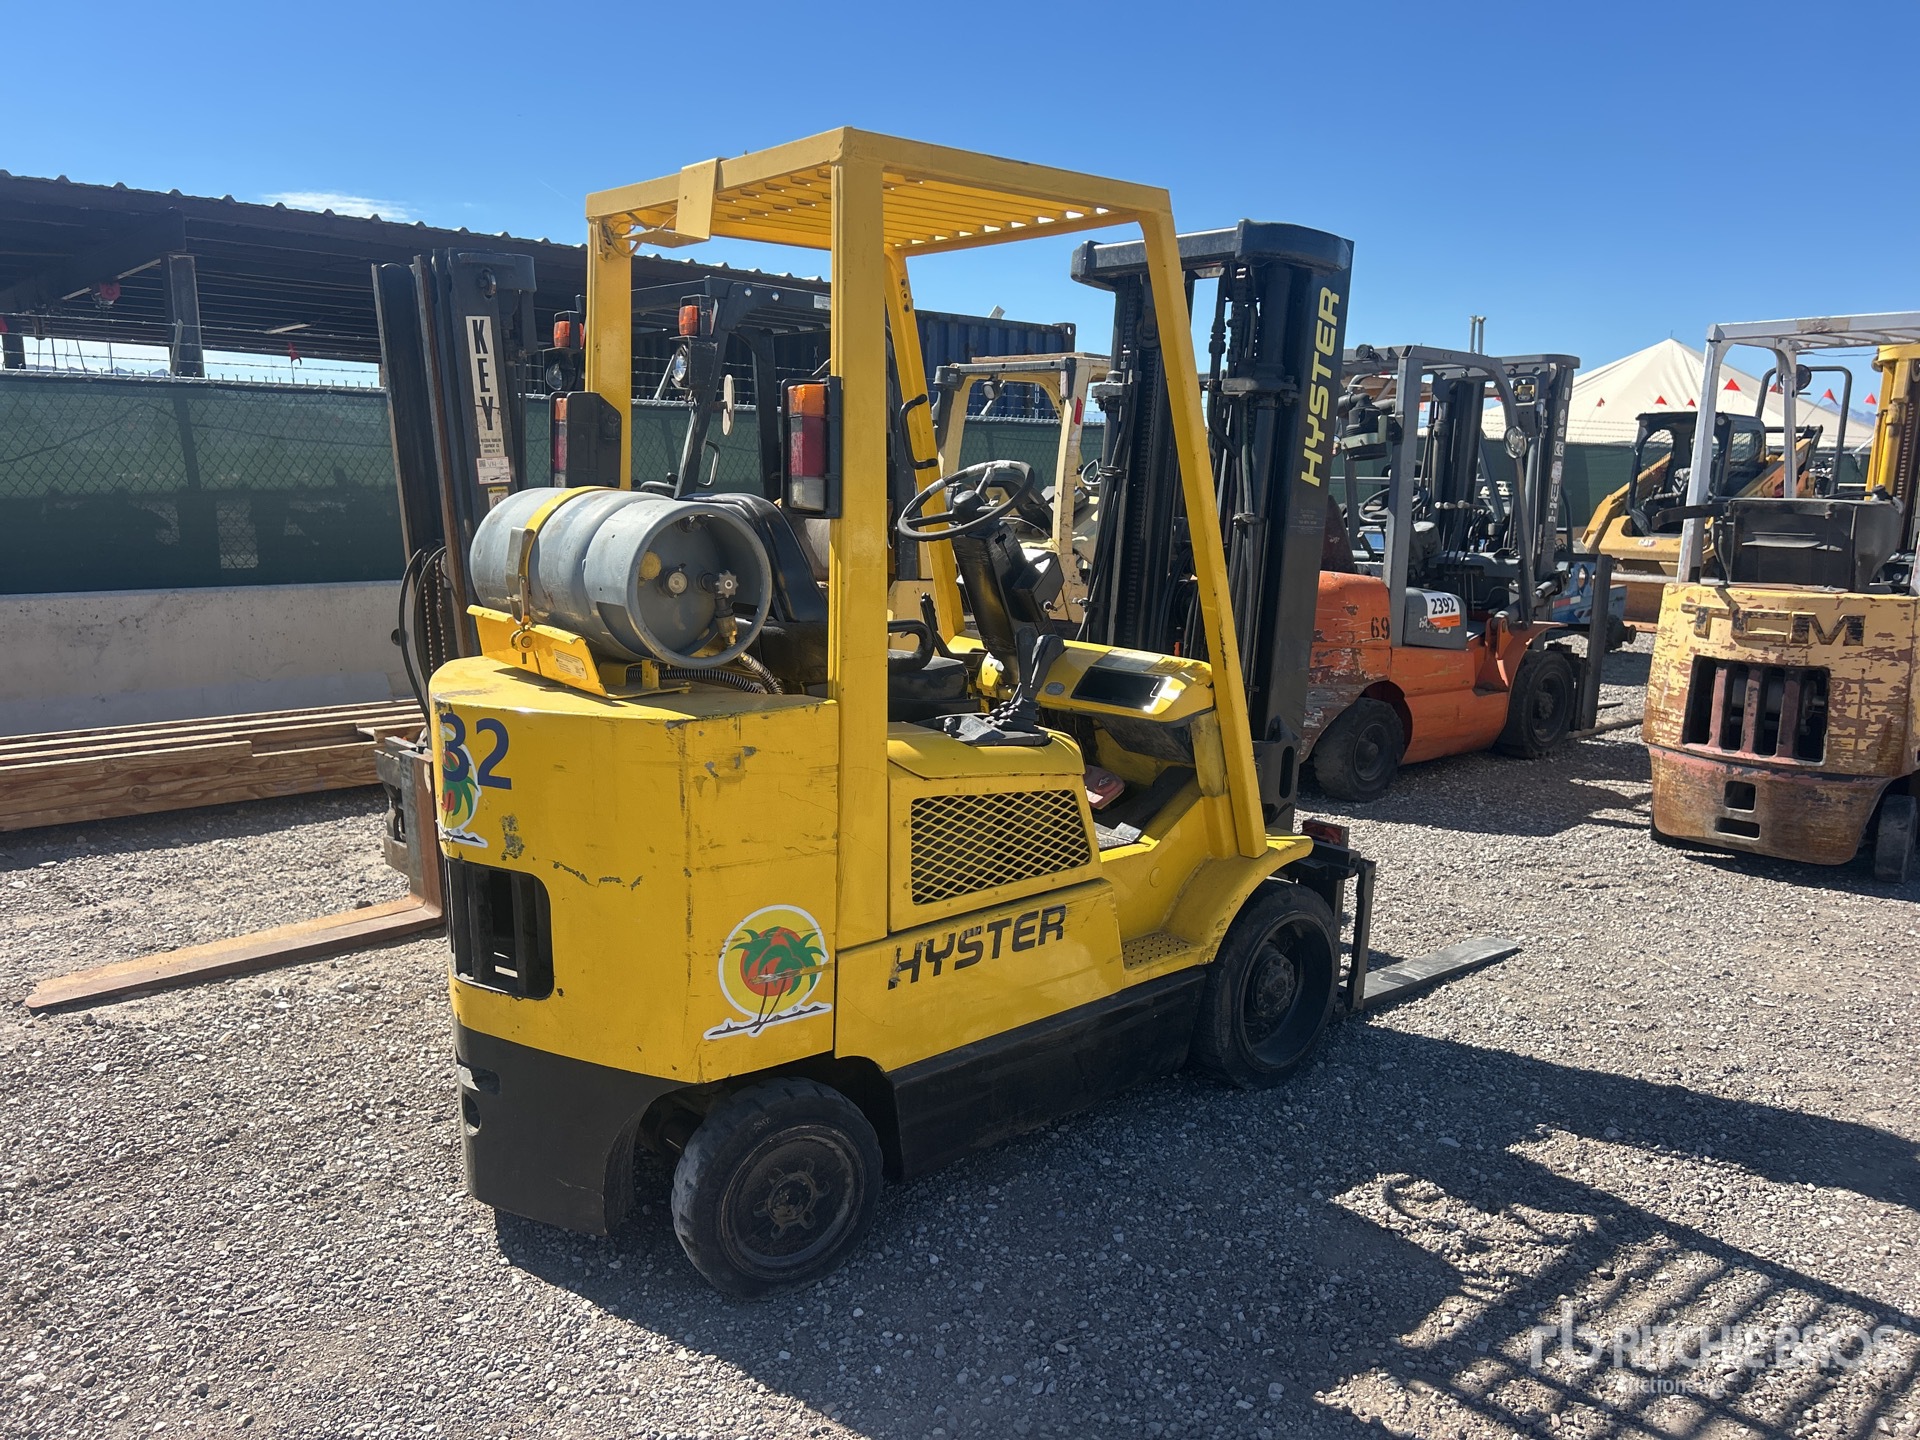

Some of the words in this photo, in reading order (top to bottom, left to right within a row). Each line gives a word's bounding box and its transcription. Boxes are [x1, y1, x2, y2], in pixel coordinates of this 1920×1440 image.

[472, 320, 493, 430] KEY
[1301, 287, 1340, 487] HYSTER
[1371, 617, 1390, 640] 69
[1431, 597, 1456, 615] 2392
[1681, 602, 1866, 647] TCM
[887, 904, 1067, 990] HYSTER
